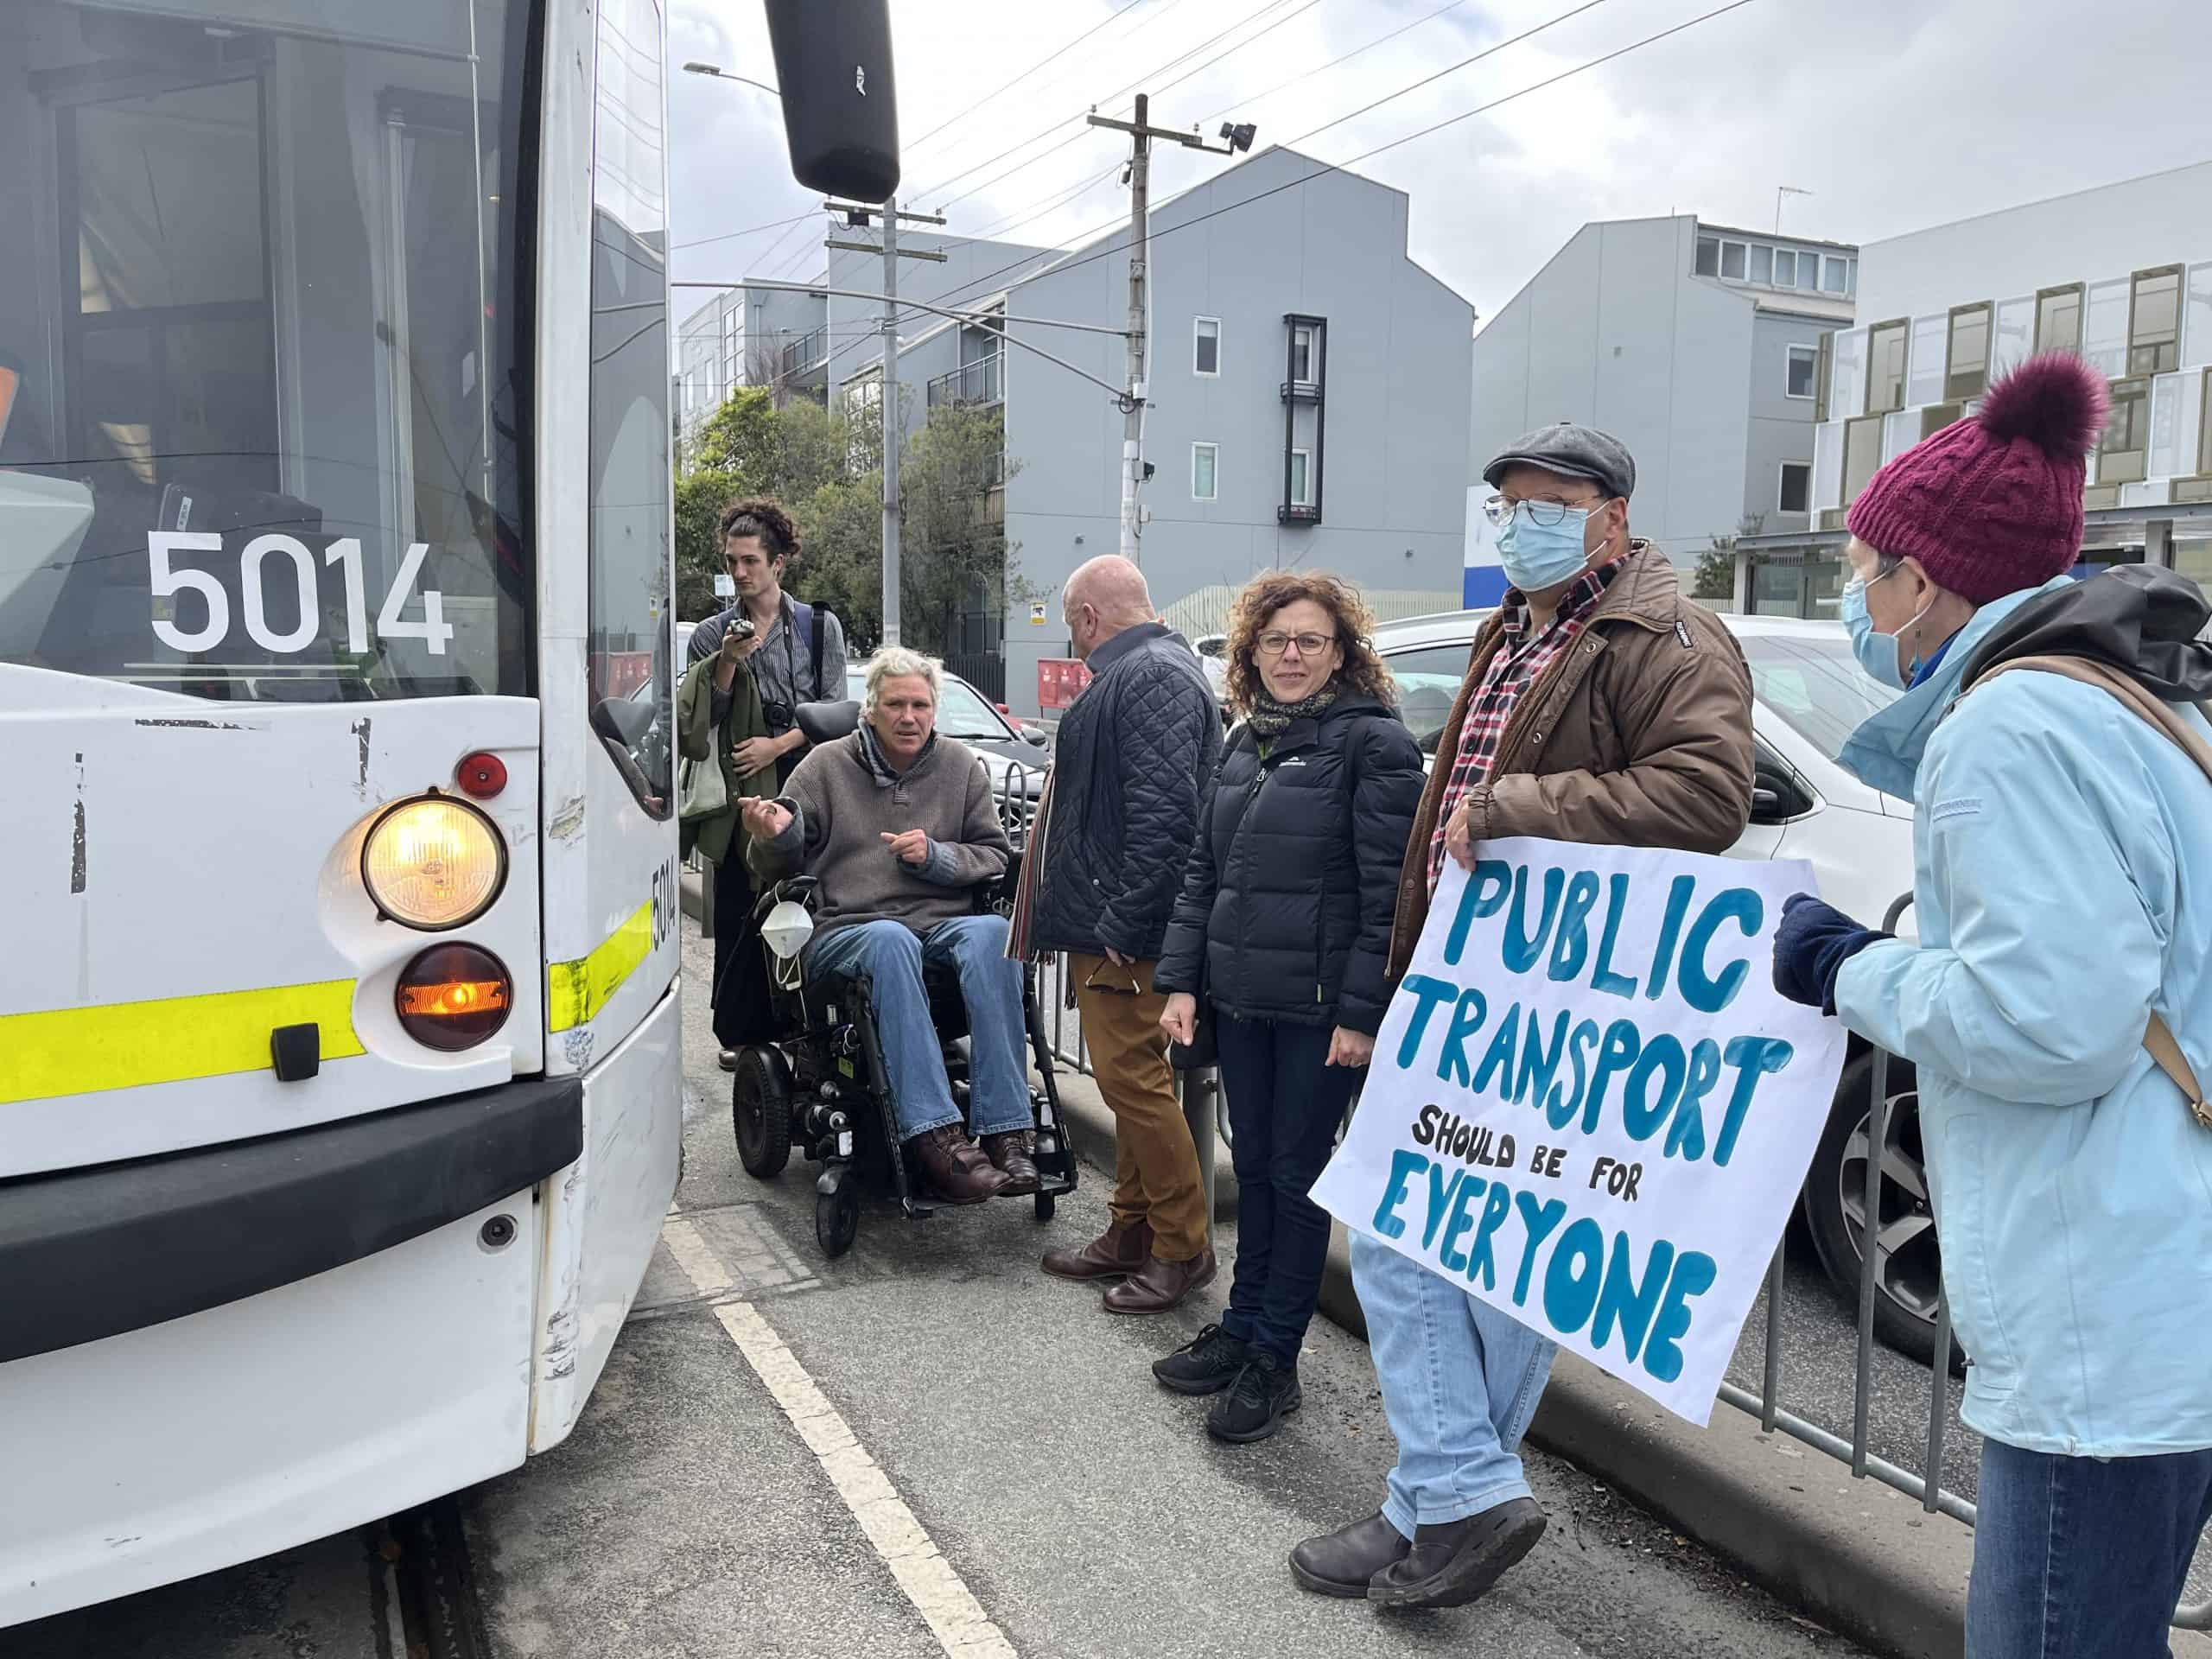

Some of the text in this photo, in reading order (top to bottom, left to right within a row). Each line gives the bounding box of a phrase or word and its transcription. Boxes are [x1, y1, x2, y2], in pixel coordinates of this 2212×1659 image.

[148, 531, 454, 655] 5014
[652, 854, 676, 952] 5014
[1444, 858, 1764, 1013] PUBLIC
[1396, 974, 1795, 1166] TRANSPORT
[1411, 1104, 1643, 1202] SHOULD BE FOR
[1371, 1148, 1717, 1383] EVERYONE
